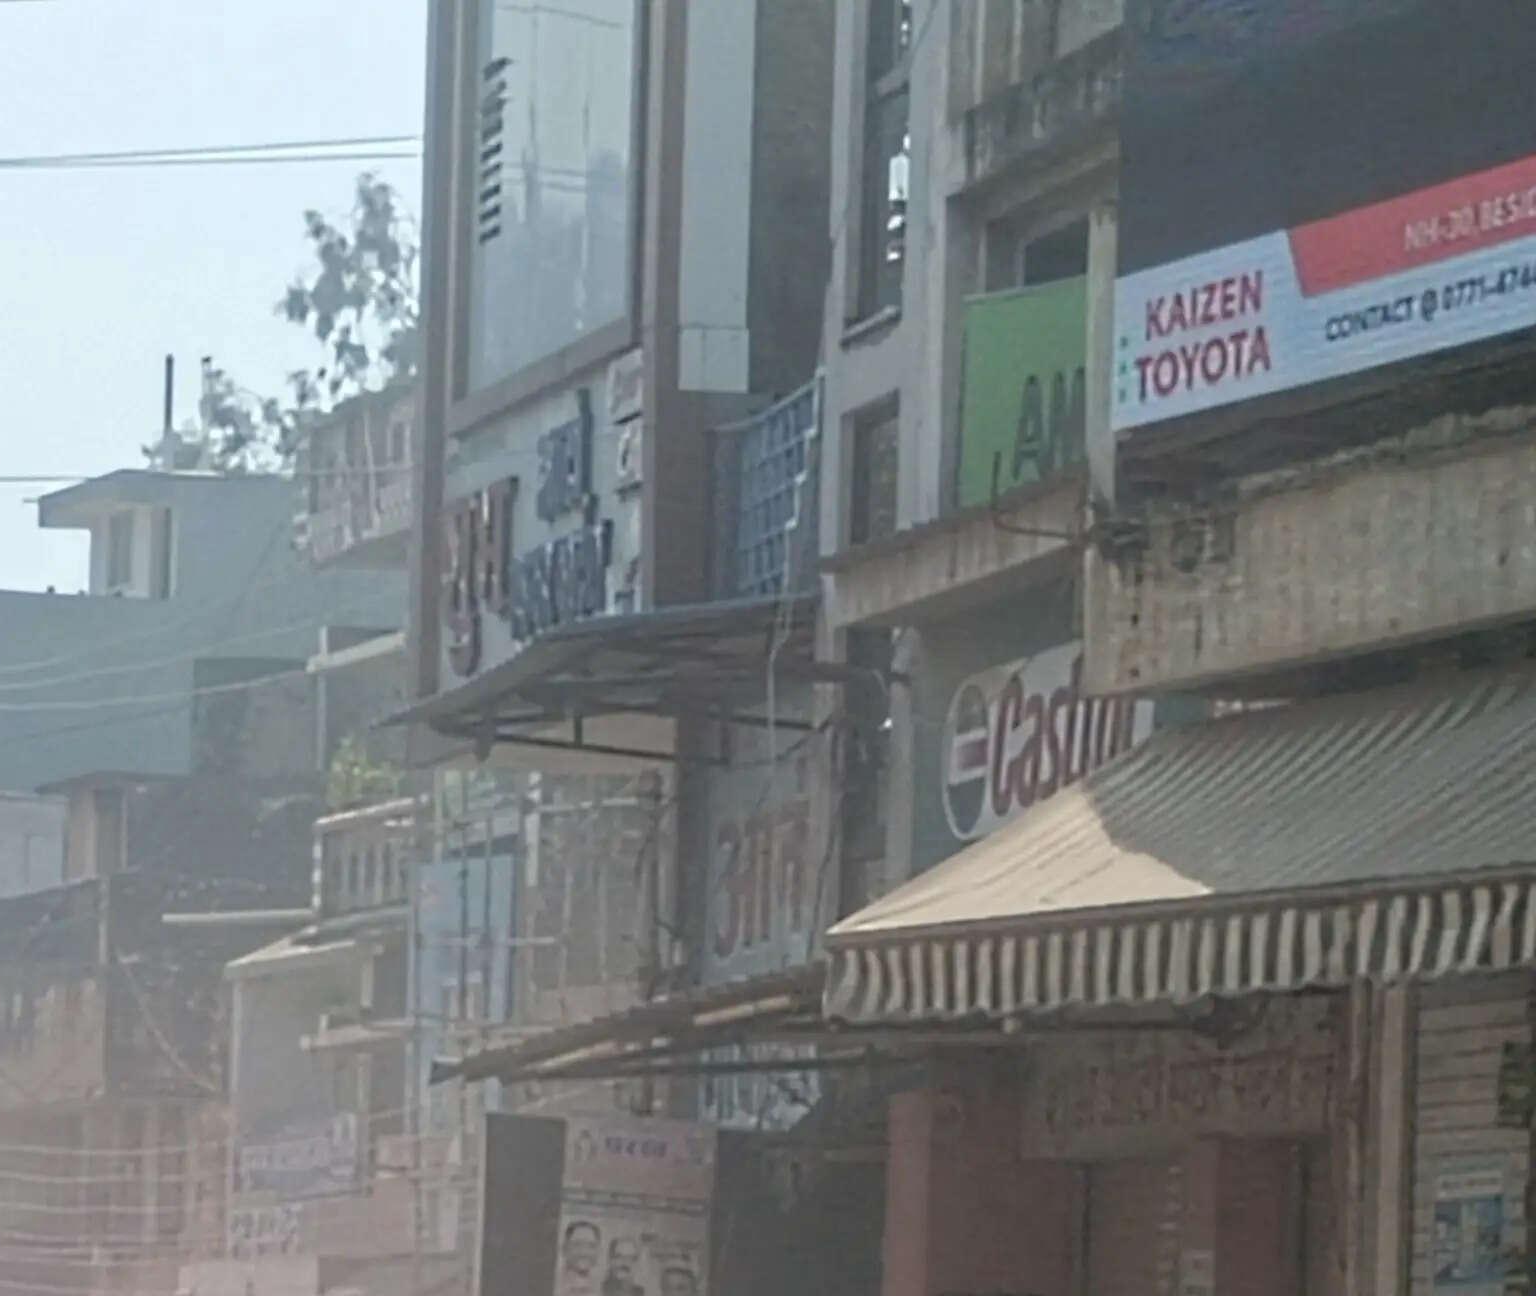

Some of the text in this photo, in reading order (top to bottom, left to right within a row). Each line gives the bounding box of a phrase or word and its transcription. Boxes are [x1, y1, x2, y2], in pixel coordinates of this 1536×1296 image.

[1144, 269, 1265, 342] KAIZEN
[1325, 296, 1415, 341] CONTACT
[1133, 325, 1272, 402] TOYOTA
